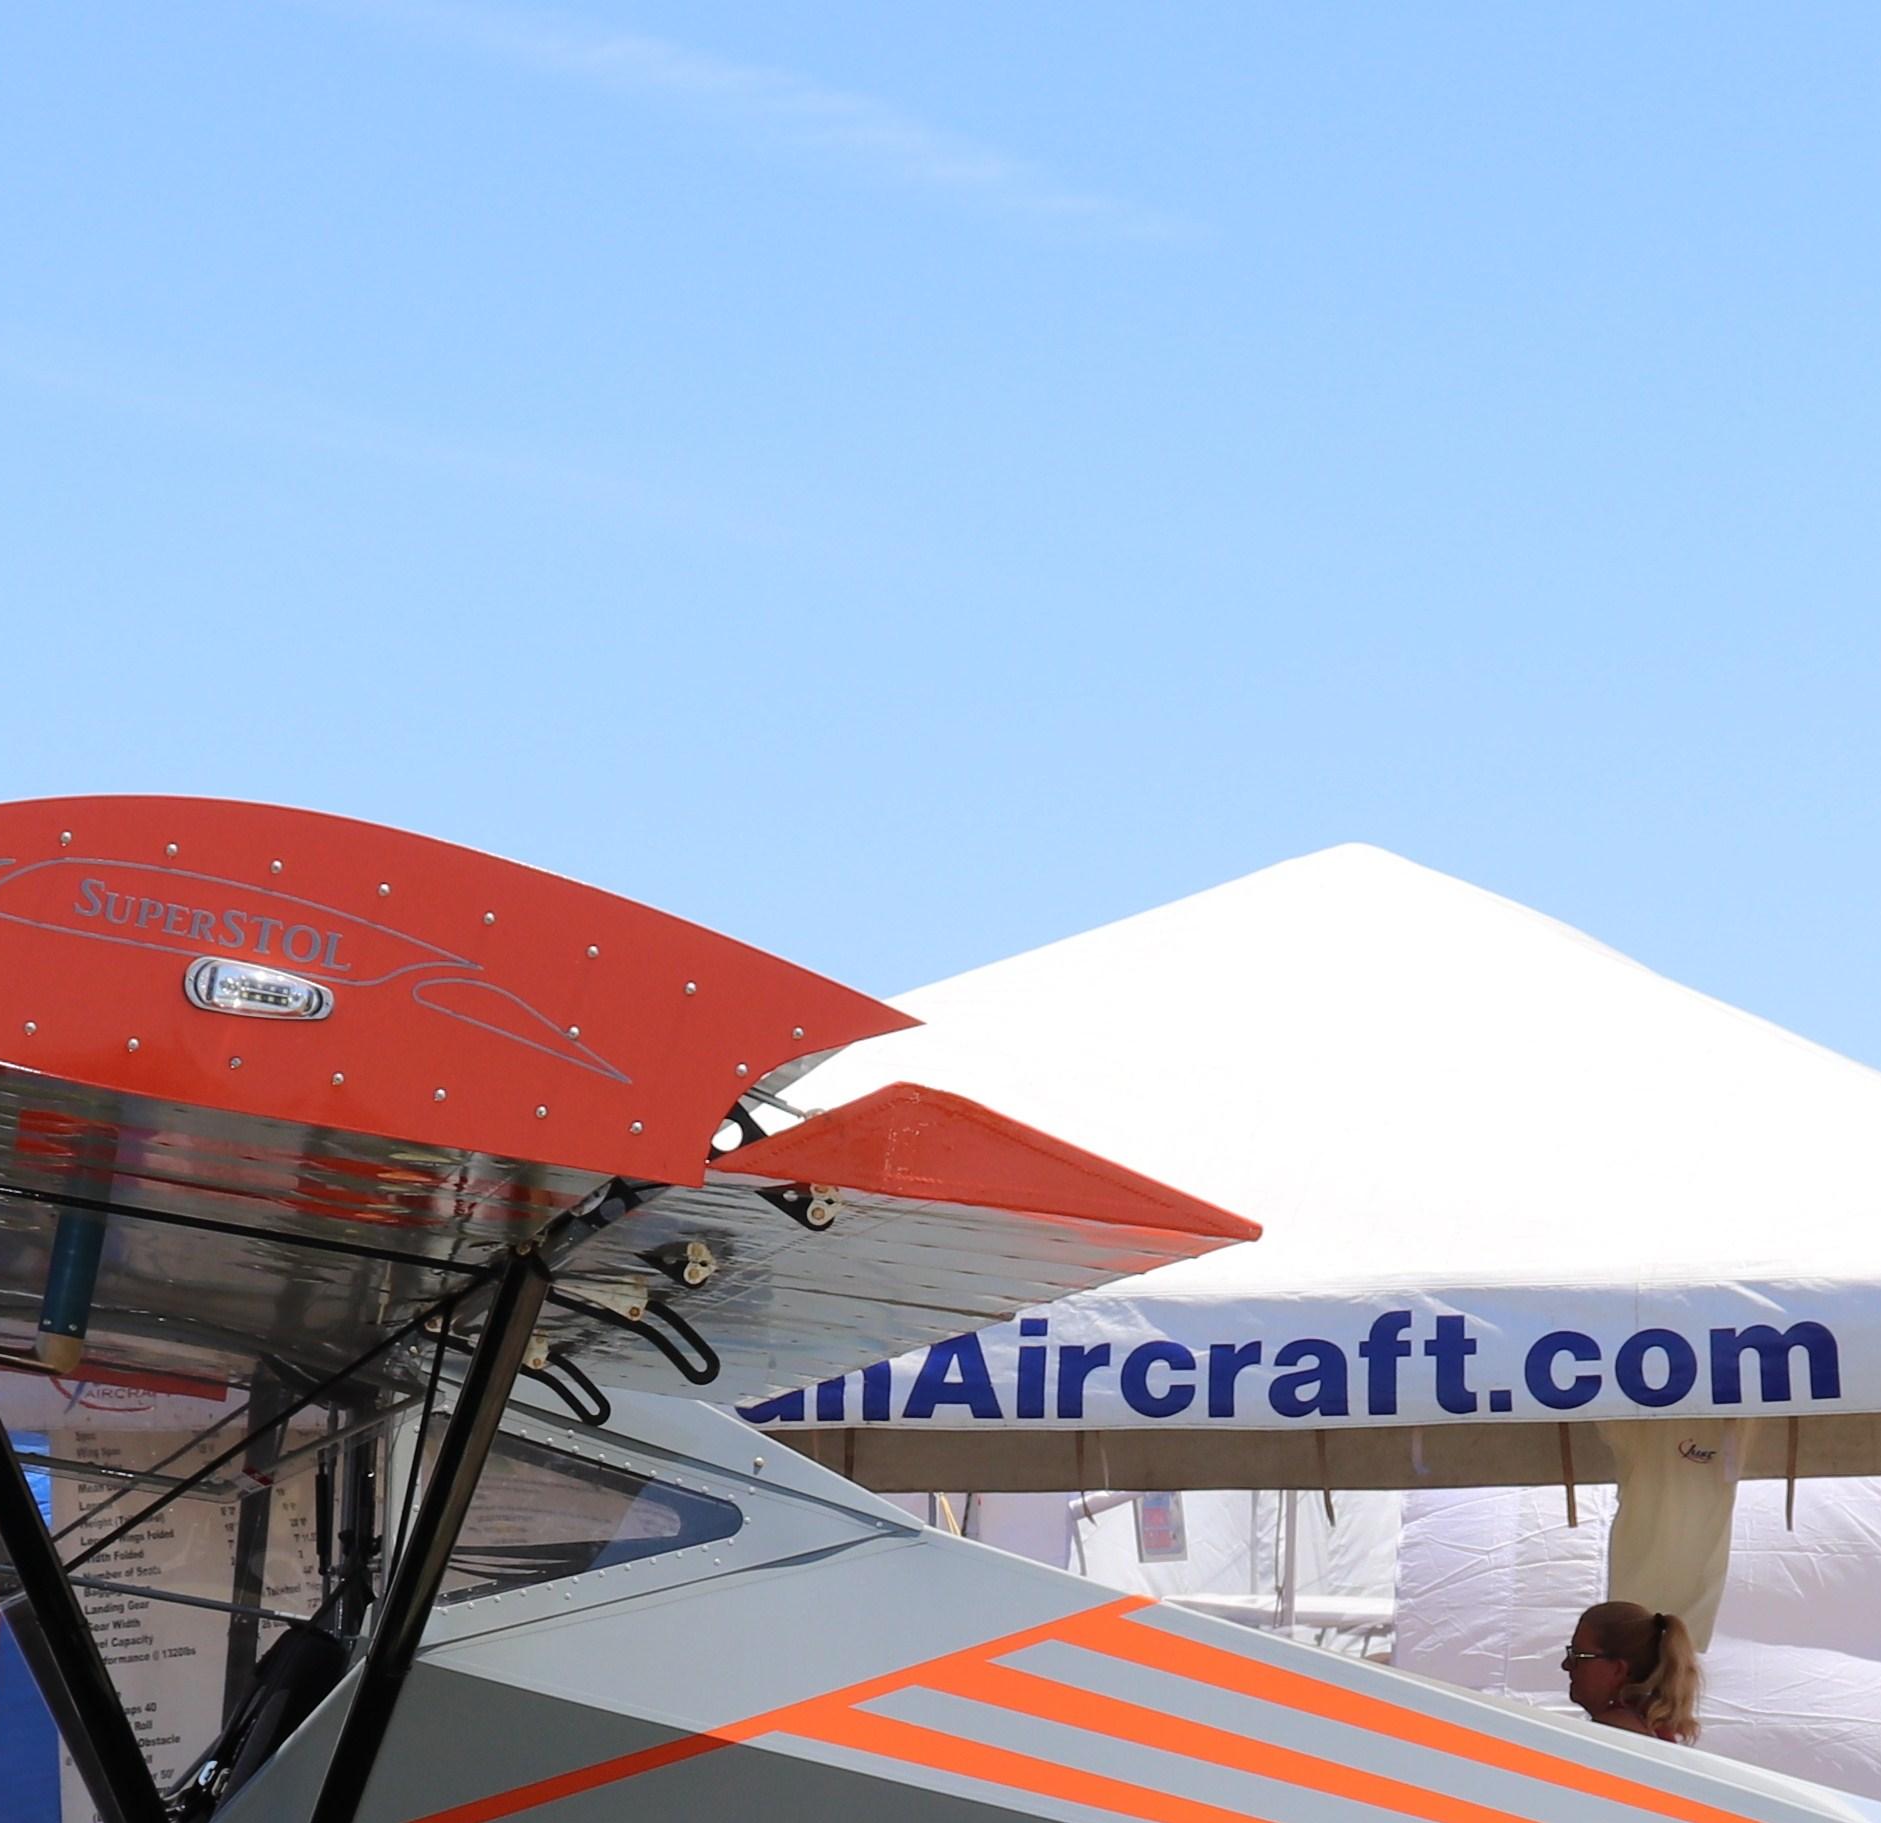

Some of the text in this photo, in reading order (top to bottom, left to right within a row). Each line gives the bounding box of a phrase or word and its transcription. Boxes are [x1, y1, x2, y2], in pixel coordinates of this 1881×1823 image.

[84, 1386, 172, 1399] AIRCRA
[83, 1599, 151, 1616] Landing Gear
[111, 1618, 141, 1630] Width
[110, 1633, 154, 1648] Capacity
[137, 1733, 182, 1748] Obstacle
